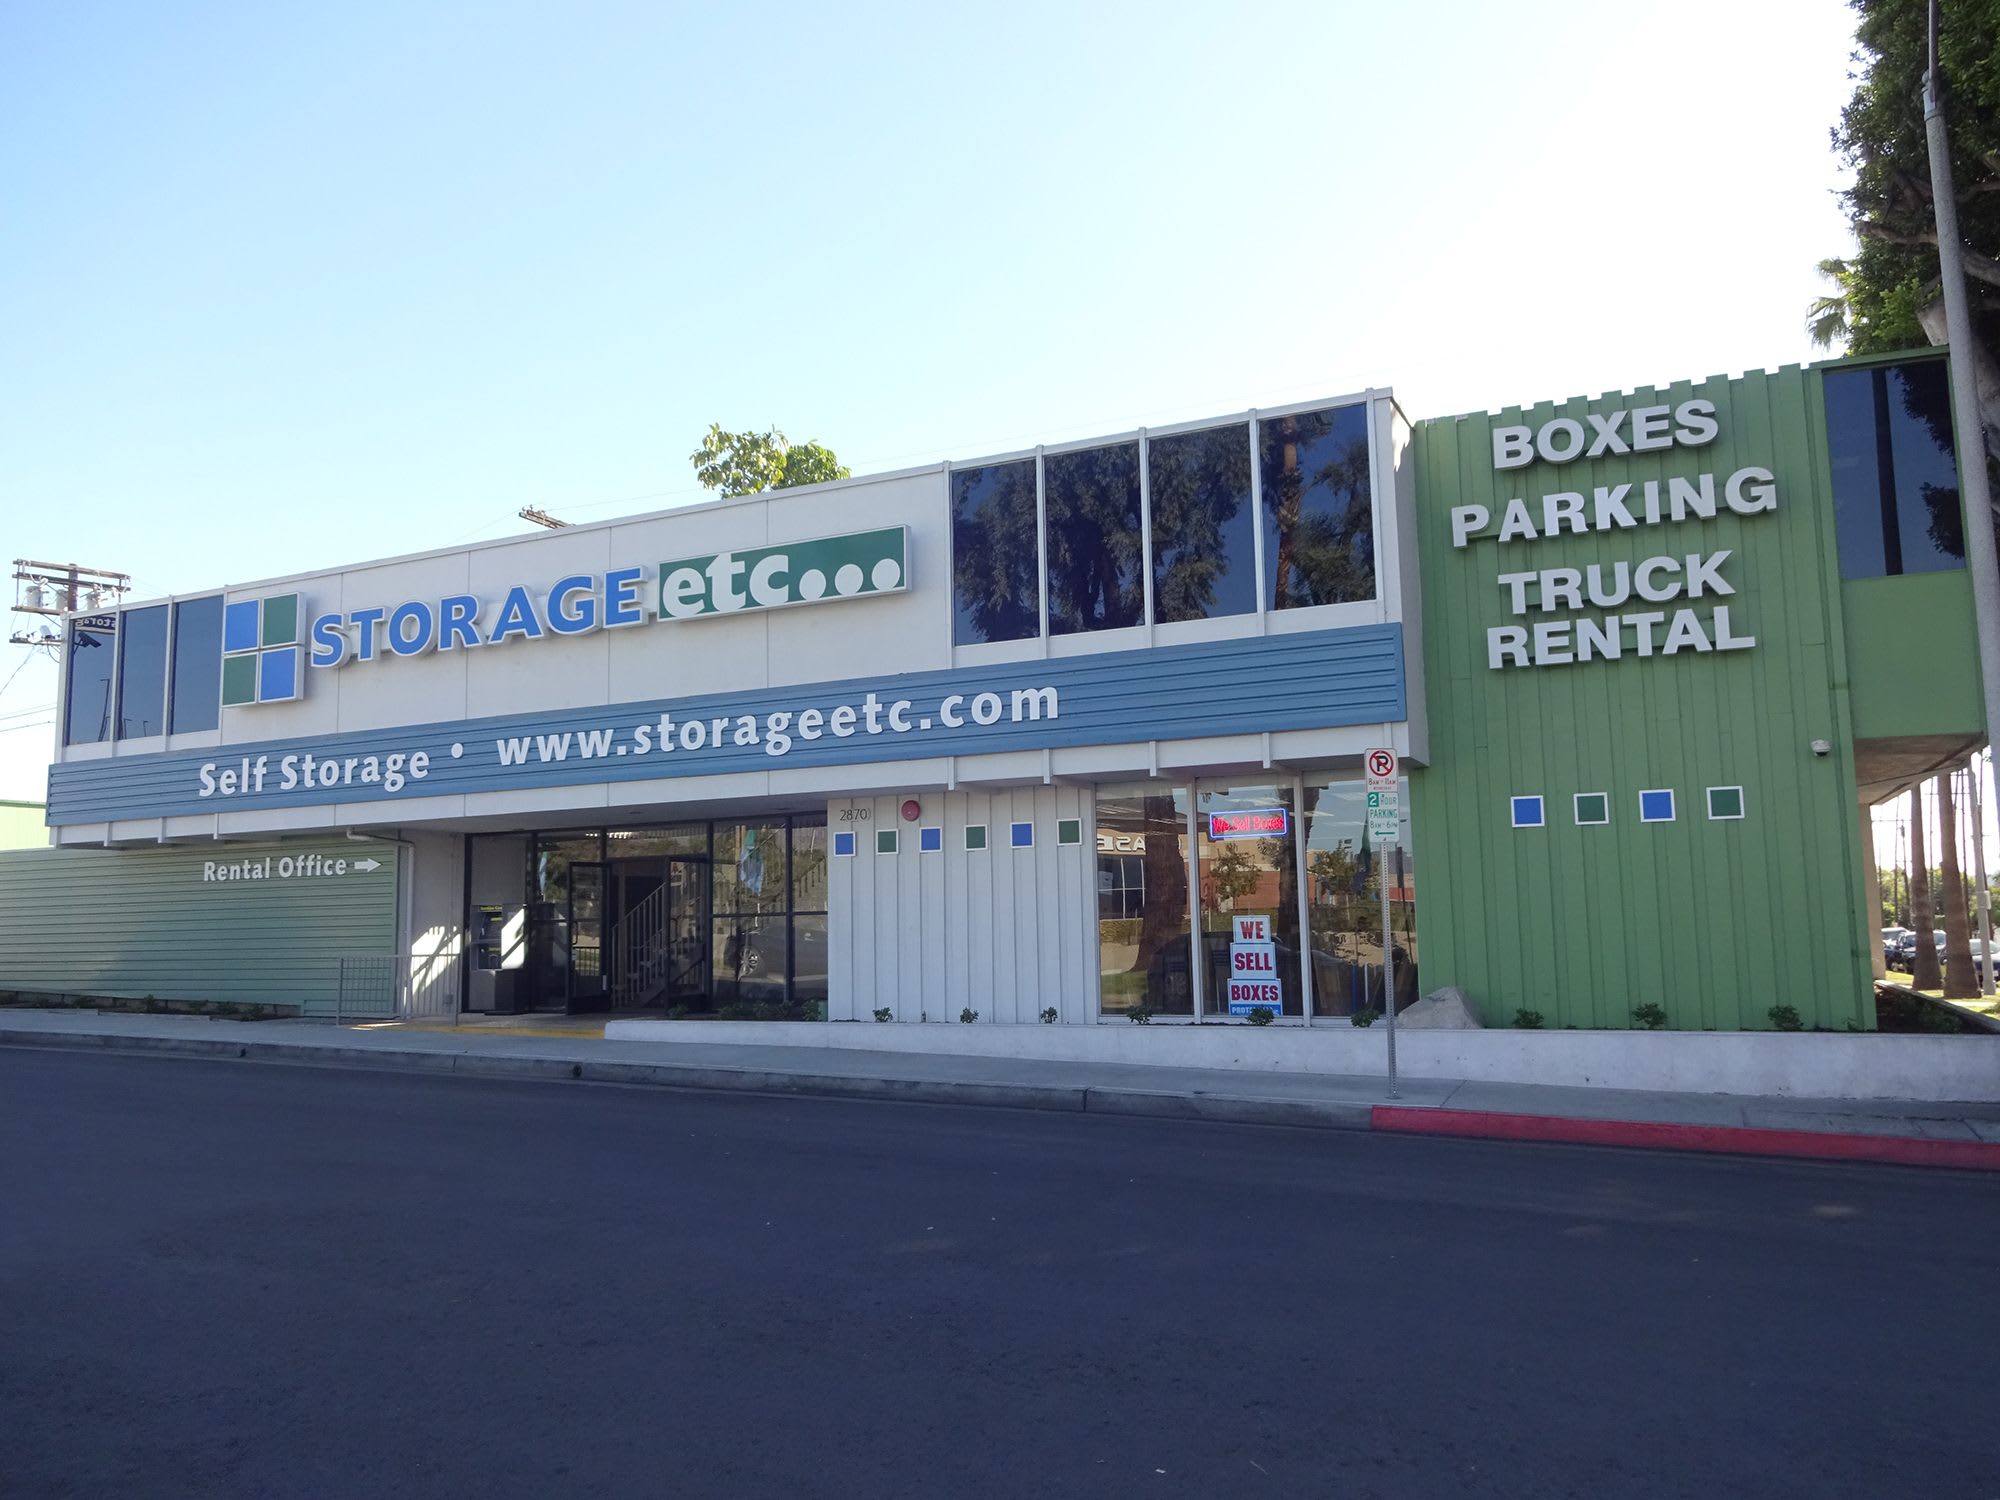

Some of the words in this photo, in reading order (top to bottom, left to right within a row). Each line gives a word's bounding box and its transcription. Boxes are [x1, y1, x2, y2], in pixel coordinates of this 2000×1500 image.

[1492, 399, 1719, 471] BOXES
[1451, 467, 1777, 548] PARKING
[1498, 550, 1736, 615] TRUCK
[310, 565, 647, 668] STORAGE
[1487, 606, 1756, 670] RENTAL
[199, 755, 267, 797] Self
[280, 751, 430, 793] Storage
[497, 686, 1059, 767] www.storageetc.com
[1369, 794, 1377, 806] 2
[1370, 808, 1398, 819] PARKING
[1213, 816, 1229, 833] We
[1232, 815, 1250, 832] Sell
[1252, 815, 1284, 831] Boxes
[203, 857, 270, 881] Rental
[278, 854, 347, 878] Office
[1240, 921, 1264, 939] WE
[1234, 952, 1273, 971] SELL
[1231, 984, 1279, 1001] BOXES
